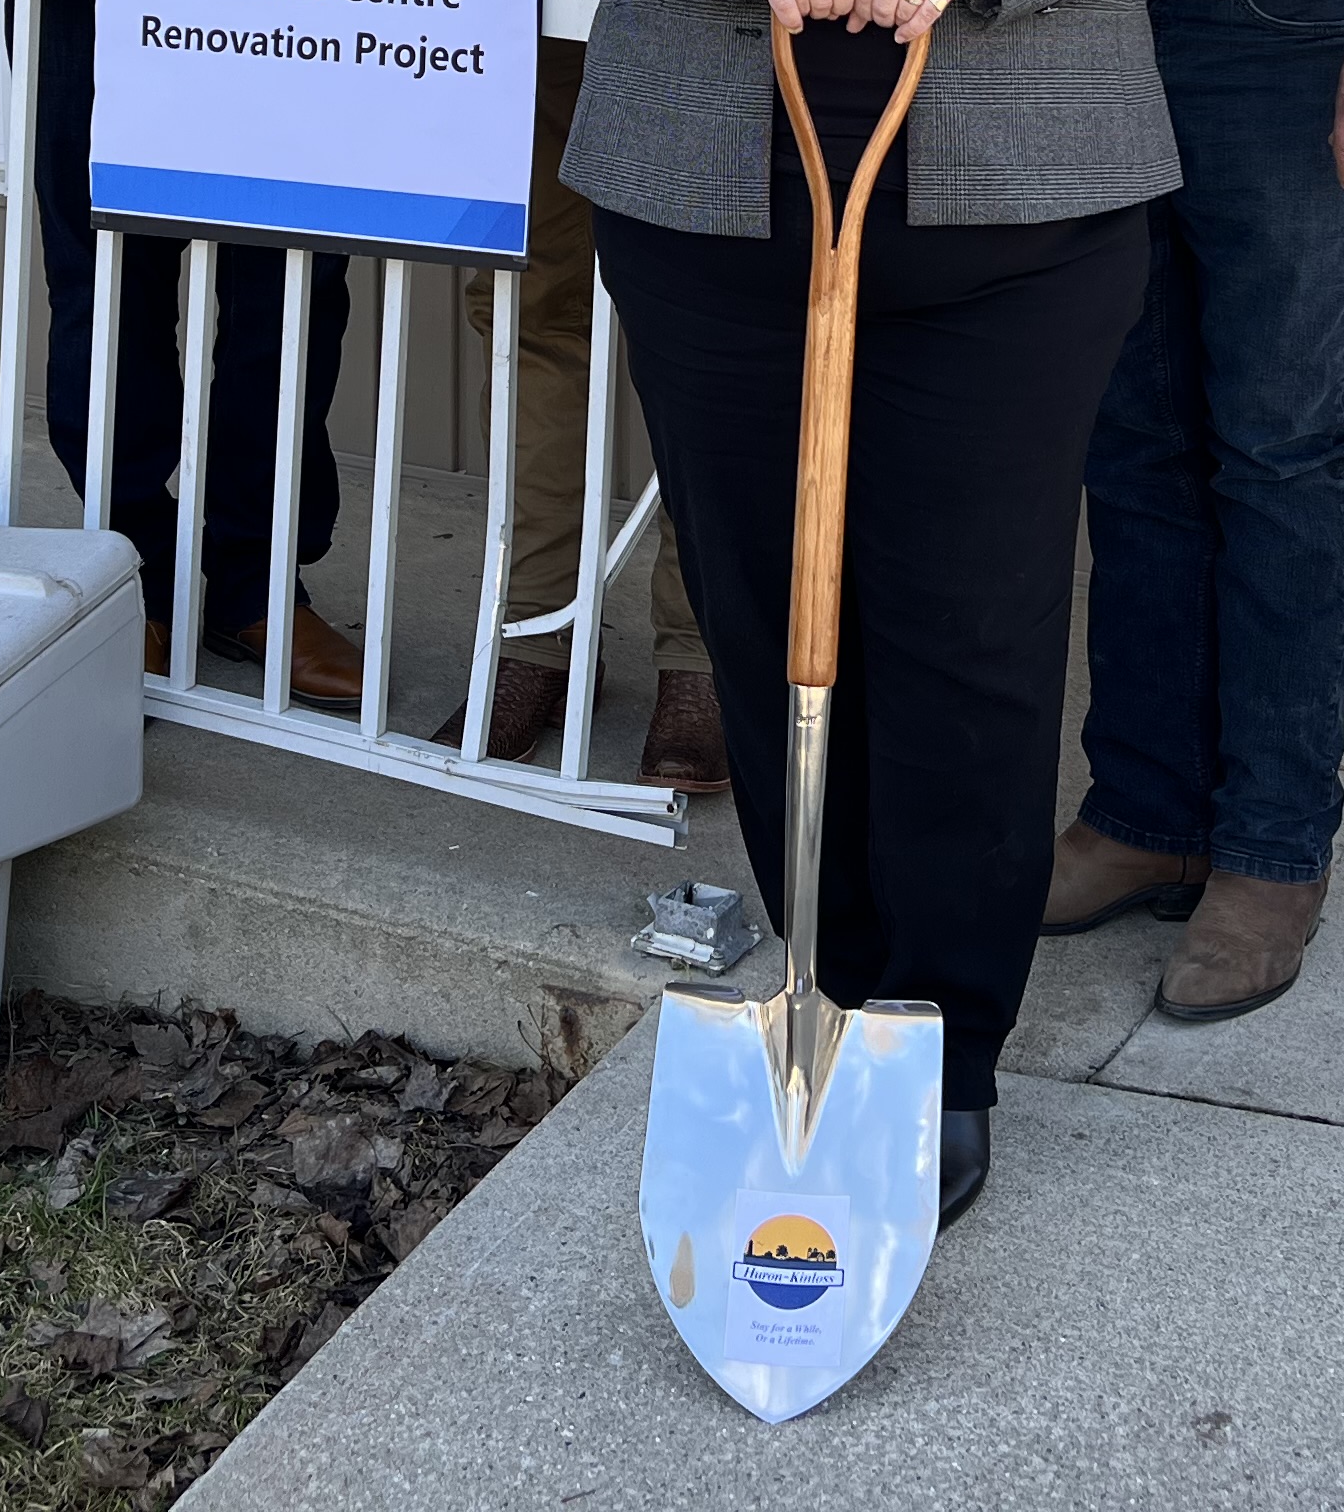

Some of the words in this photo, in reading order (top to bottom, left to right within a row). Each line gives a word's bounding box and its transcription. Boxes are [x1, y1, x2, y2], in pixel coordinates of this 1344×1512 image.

[141, 15, 341, 63] Renovation
[355, 32, 486, 79] Project
[743, 1266, 836, 1284] Huron-Kinloss
